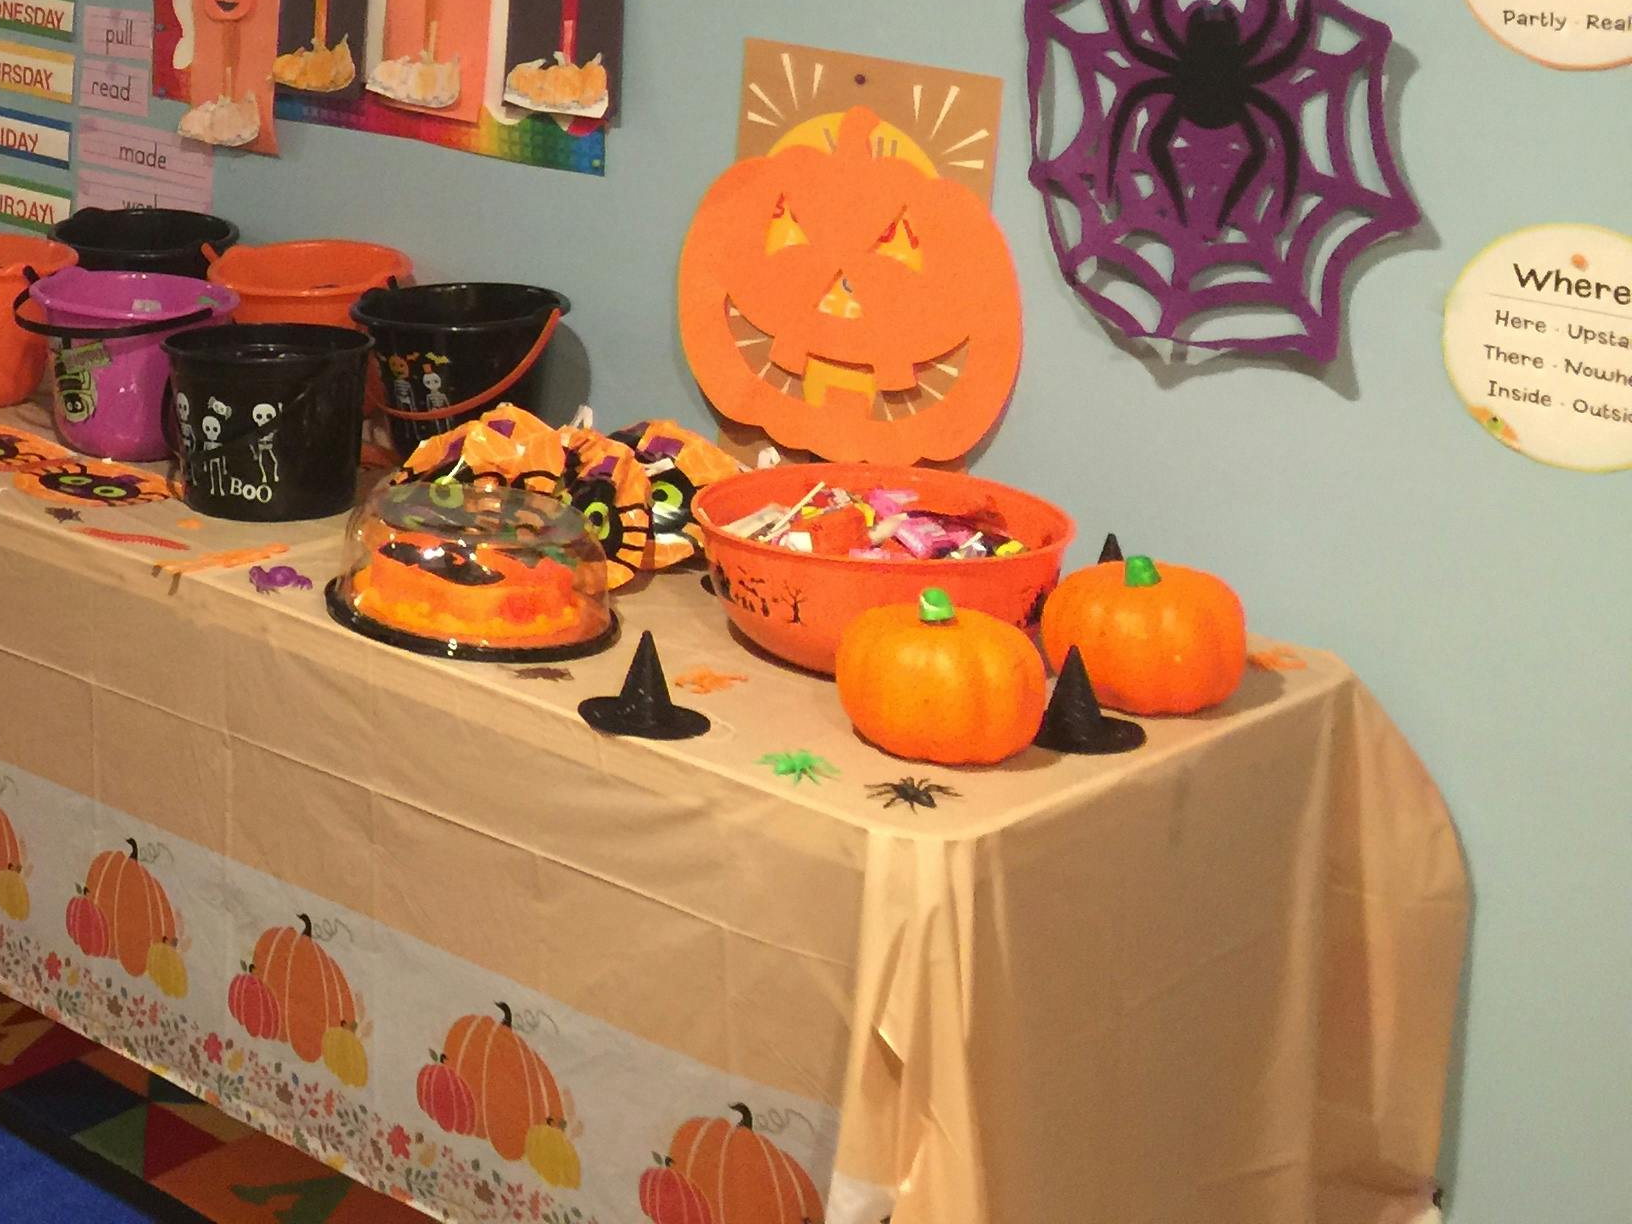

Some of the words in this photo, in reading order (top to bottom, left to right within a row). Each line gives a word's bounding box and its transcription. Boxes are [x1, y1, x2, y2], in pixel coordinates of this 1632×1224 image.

[1503, 9, 1567, 31] Partly
[105, 20, 133, 55] pull
[92, 76, 131, 102] read
[119, 142, 167, 170] made
[1513, 263, 1631, 305] Where
[1495, 309, 1547, 333] Here
[1483, 344, 1544, 369] There
[1488, 380, 1552, 407] Inside
[230, 477, 272, 503] BOO
